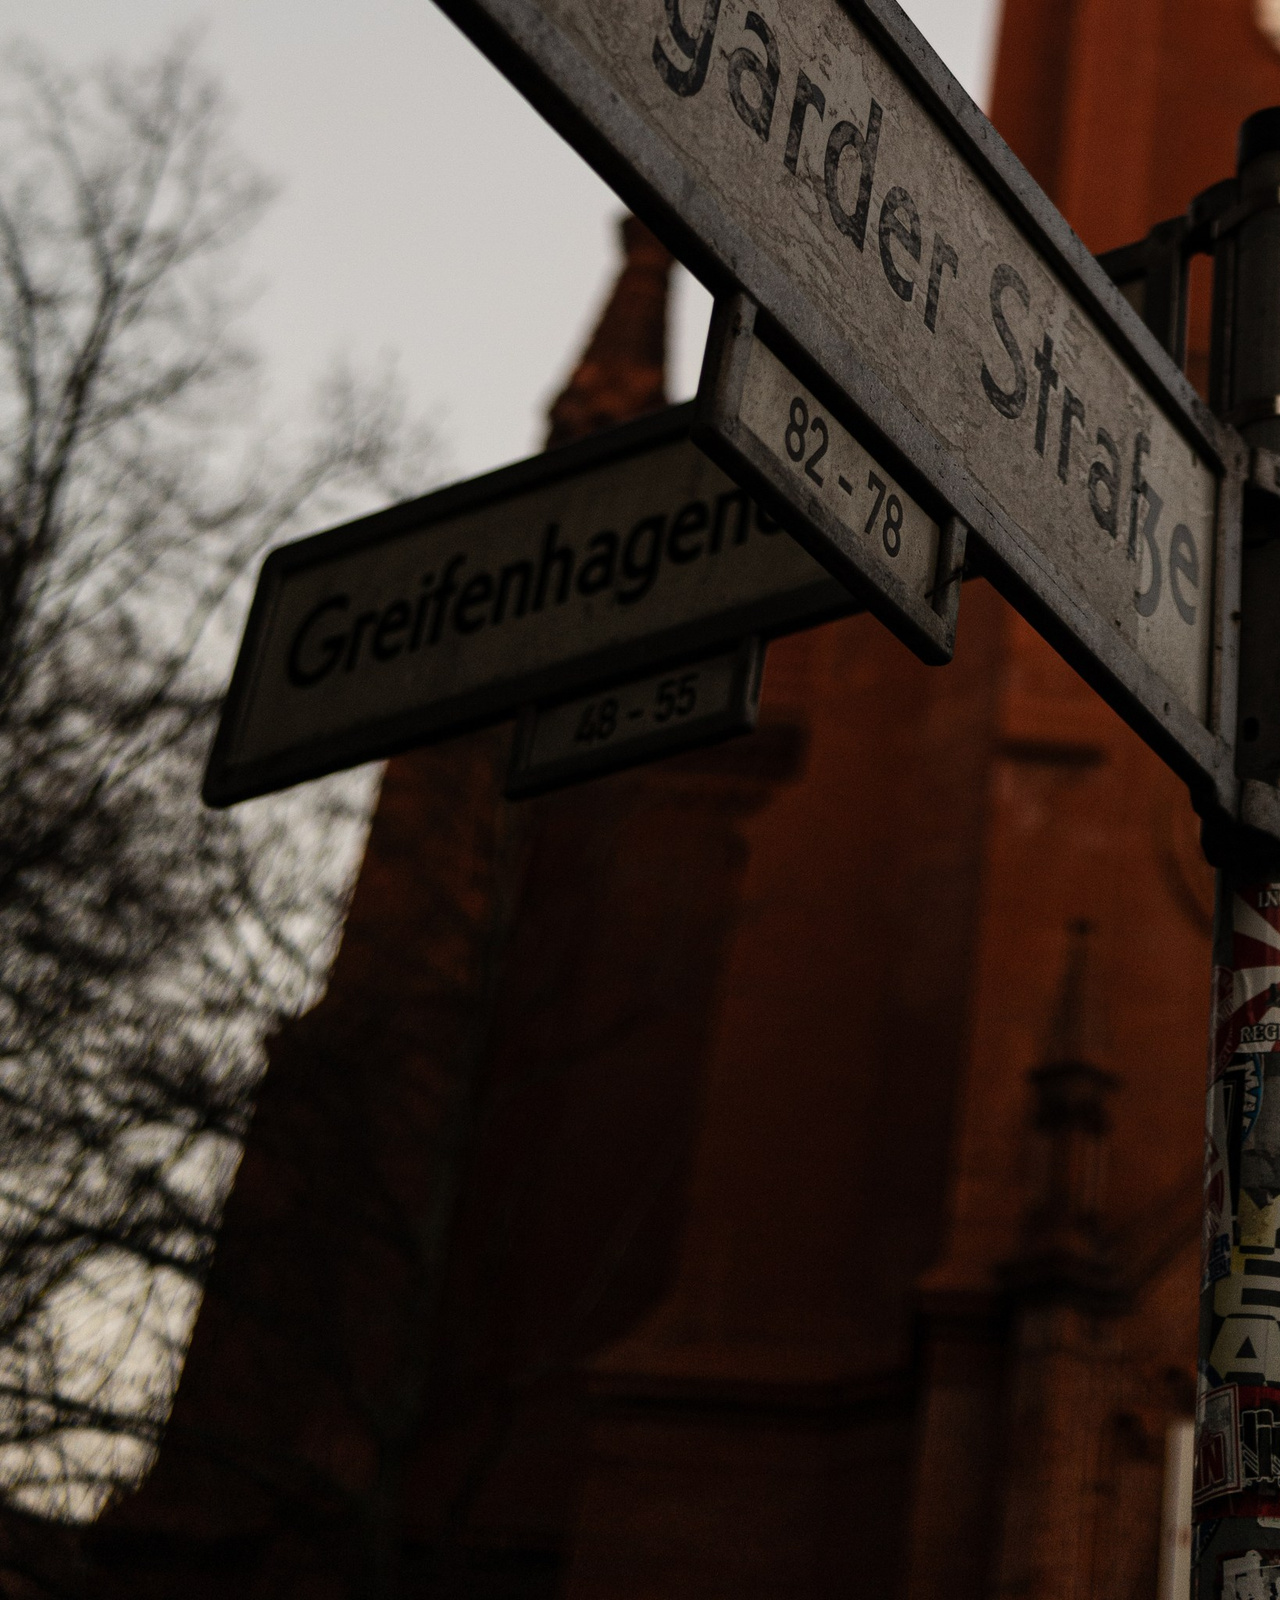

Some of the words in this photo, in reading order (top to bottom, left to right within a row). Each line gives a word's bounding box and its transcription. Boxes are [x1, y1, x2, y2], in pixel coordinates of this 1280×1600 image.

[783, 396, 829, 487] 82
[862, 470, 905, 560] 78
[980, 263, 1199, 626] Straße
[572, 698, 618, 744] 48
[653, 674, 700, 720] 55
[1258, 889, 1280, 909] IN
